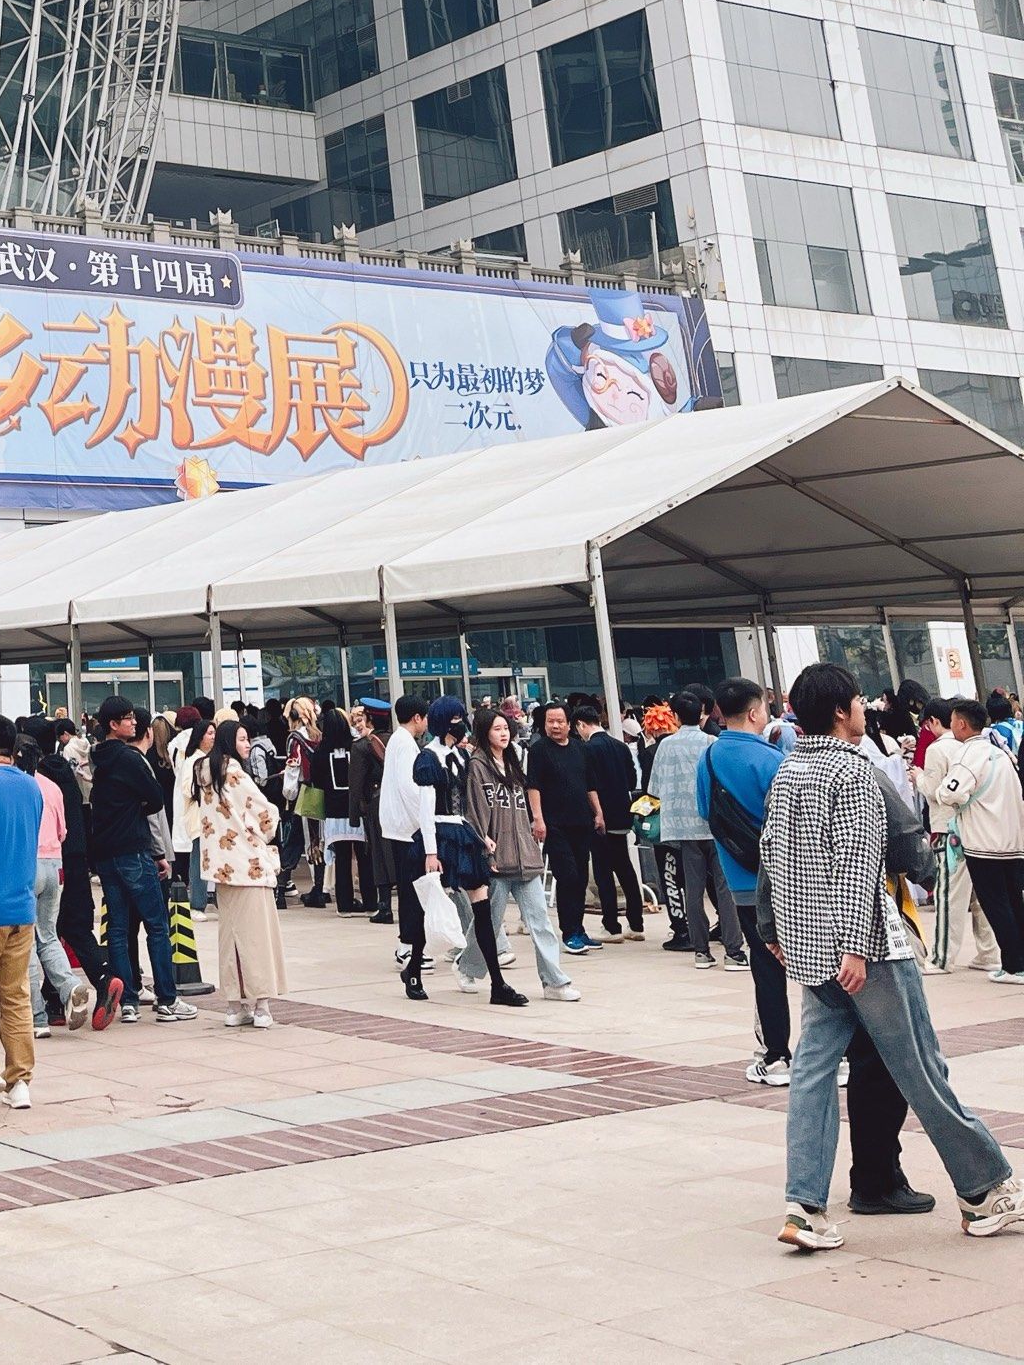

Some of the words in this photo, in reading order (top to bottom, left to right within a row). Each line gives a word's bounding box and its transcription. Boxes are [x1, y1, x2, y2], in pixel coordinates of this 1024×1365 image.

[409, 361, 546, 397] 只为最初的梦
[665, 852, 683, 919] STRIPES
